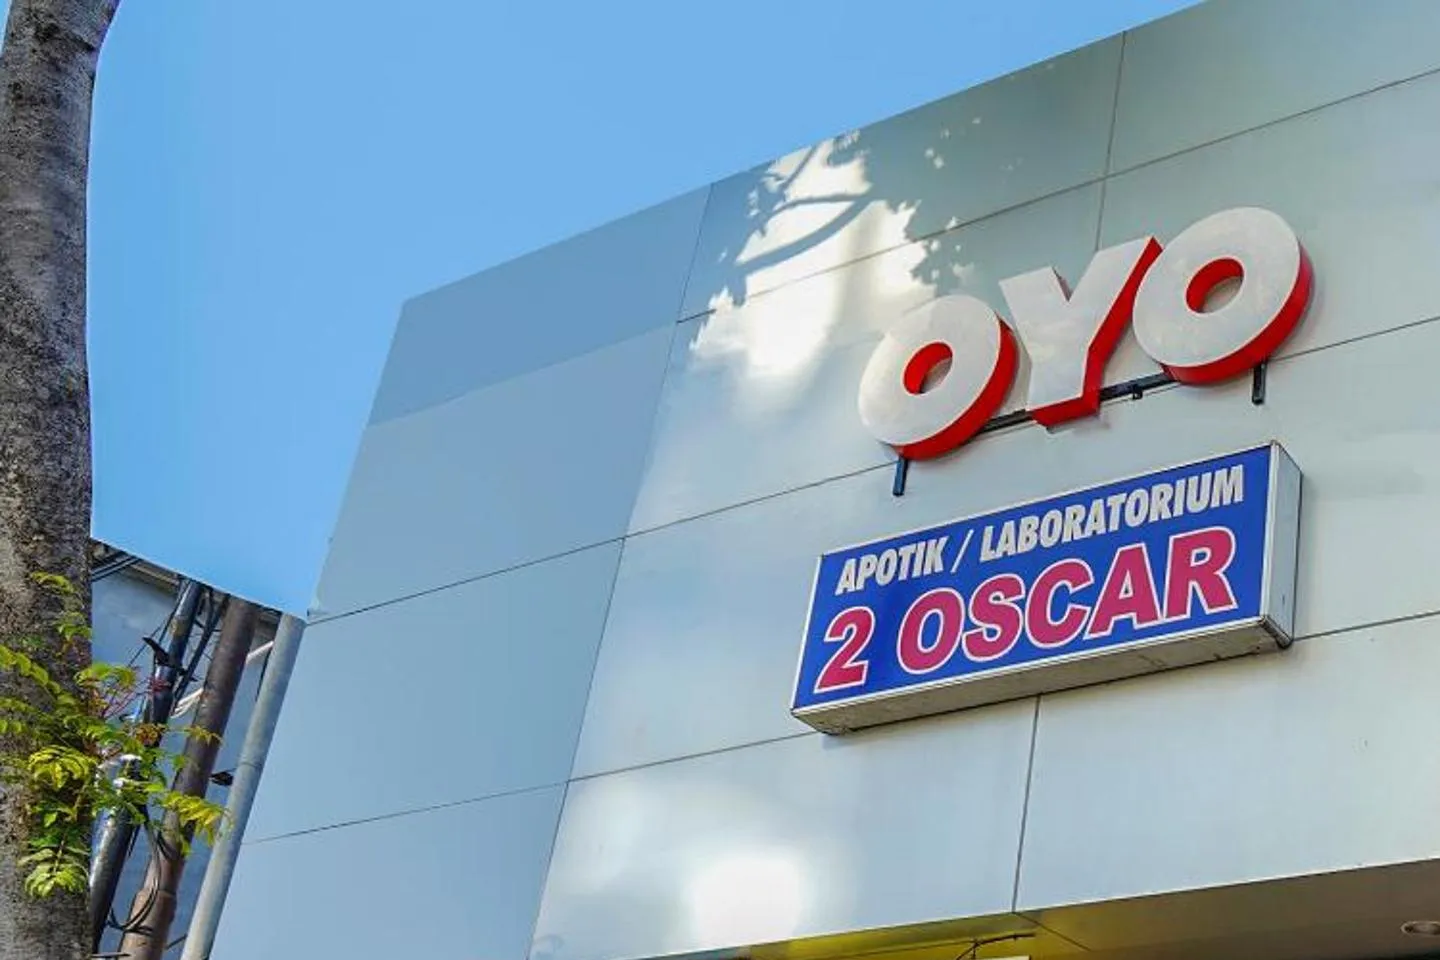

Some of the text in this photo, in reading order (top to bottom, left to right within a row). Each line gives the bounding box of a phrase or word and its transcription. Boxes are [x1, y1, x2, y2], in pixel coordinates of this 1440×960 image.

[858, 206, 1312, 458] OYO
[813, 526, 1238, 694] 2 OSCAR
[835, 534, 949, 596] APOTIK
[980, 464, 1244, 561] LABORATORIUM
